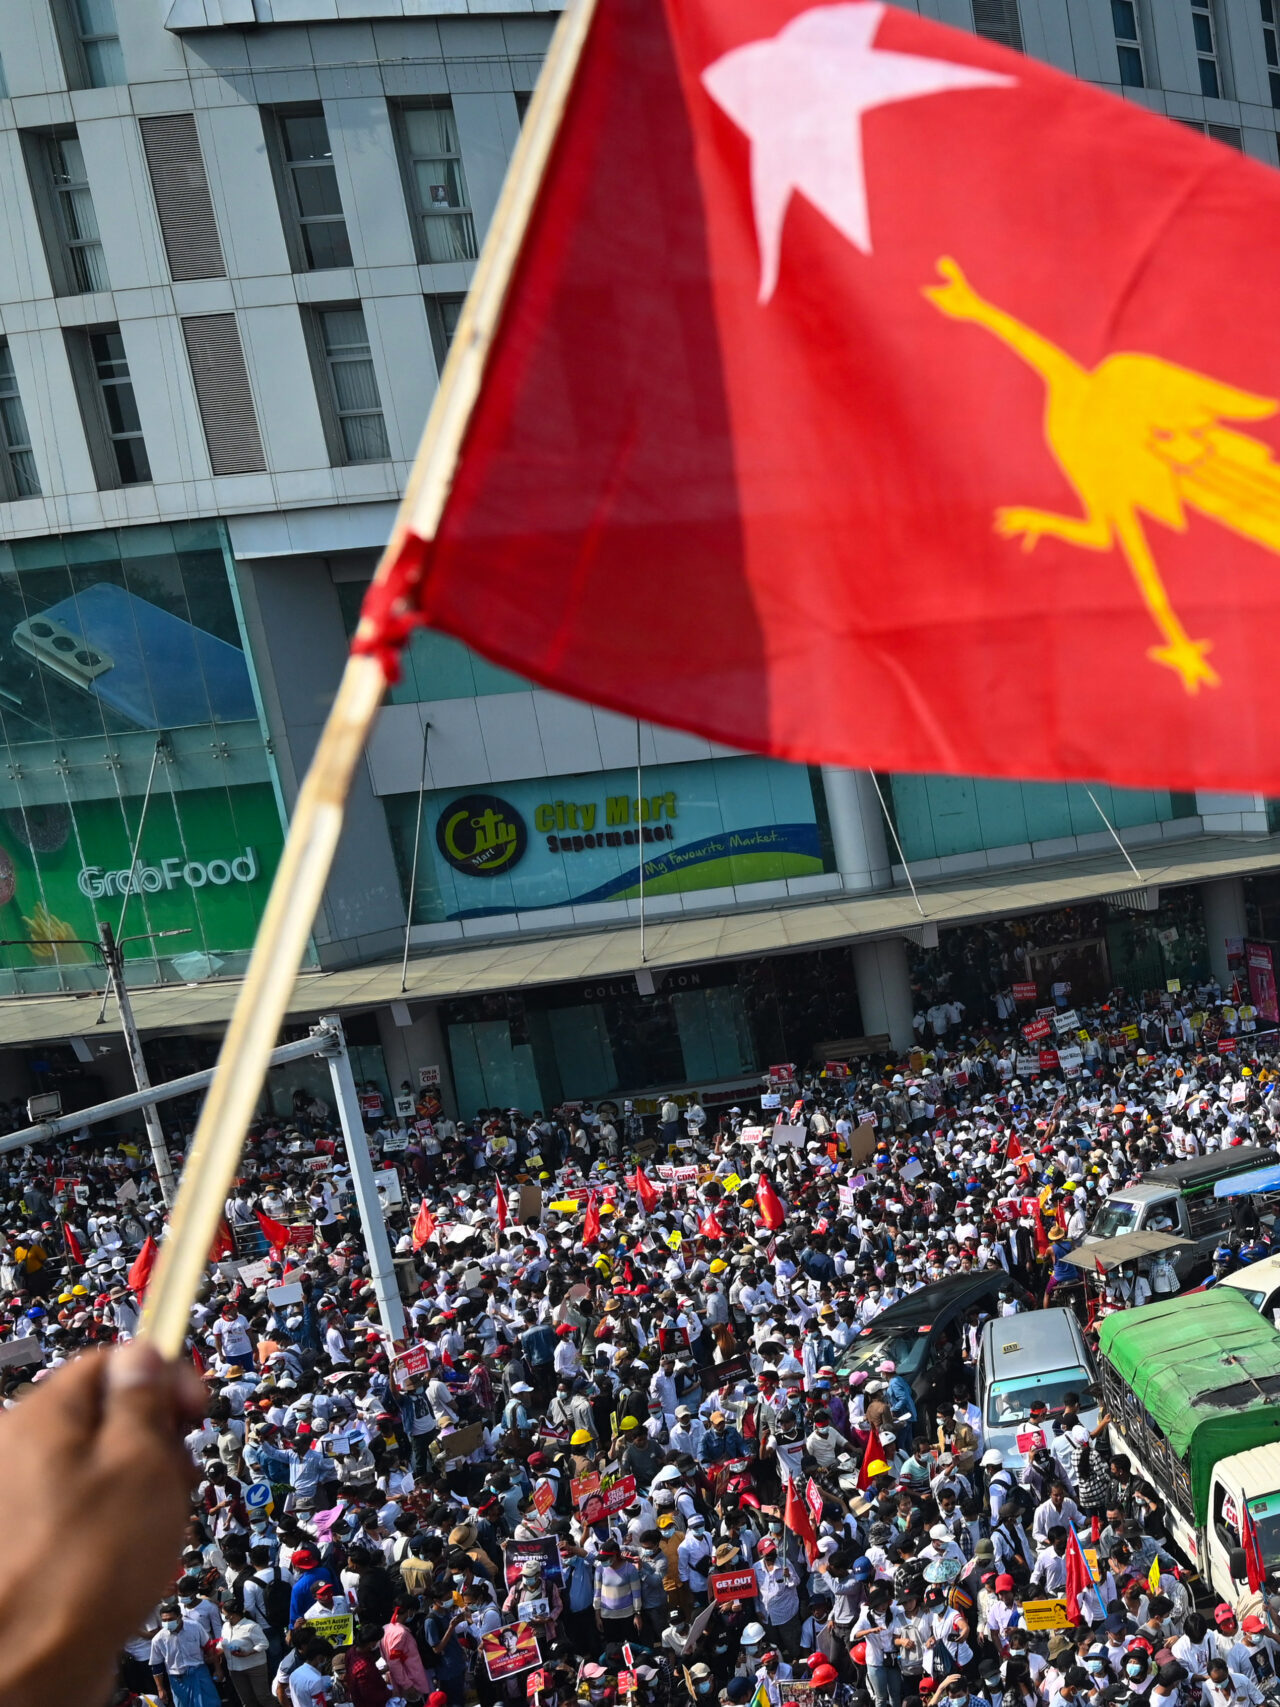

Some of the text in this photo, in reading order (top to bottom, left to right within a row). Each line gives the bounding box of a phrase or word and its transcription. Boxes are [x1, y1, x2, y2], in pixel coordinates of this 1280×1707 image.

[534, 791, 678, 832] City Mart
[445, 808, 518, 869] City
[546, 823, 675, 854] Supermarket
[481, 848, 502, 867] Mart
[645, 861, 668, 878] My
[668, 842, 726, 868] Favourite
[77, 846, 259, 899] GrabFood
[584, 973, 701, 999] COLLEION
[1033, 1020, 1047, 1030] Fight
[422, 1075, 438, 1083] CDM
[311, 1162, 329, 1171] CDM
[677, 1173, 697, 1182] CDM
[1004, 1344, 1018, 1352] TAXI
[409, 1364, 427, 1374] Leader
[608, 1486, 624, 1496] FREE
[517, 1544, 542, 1553] STOP
[513, 1554, 549, 1562] ARRESTING
[716, 1576, 752, 1589] GET OUT
